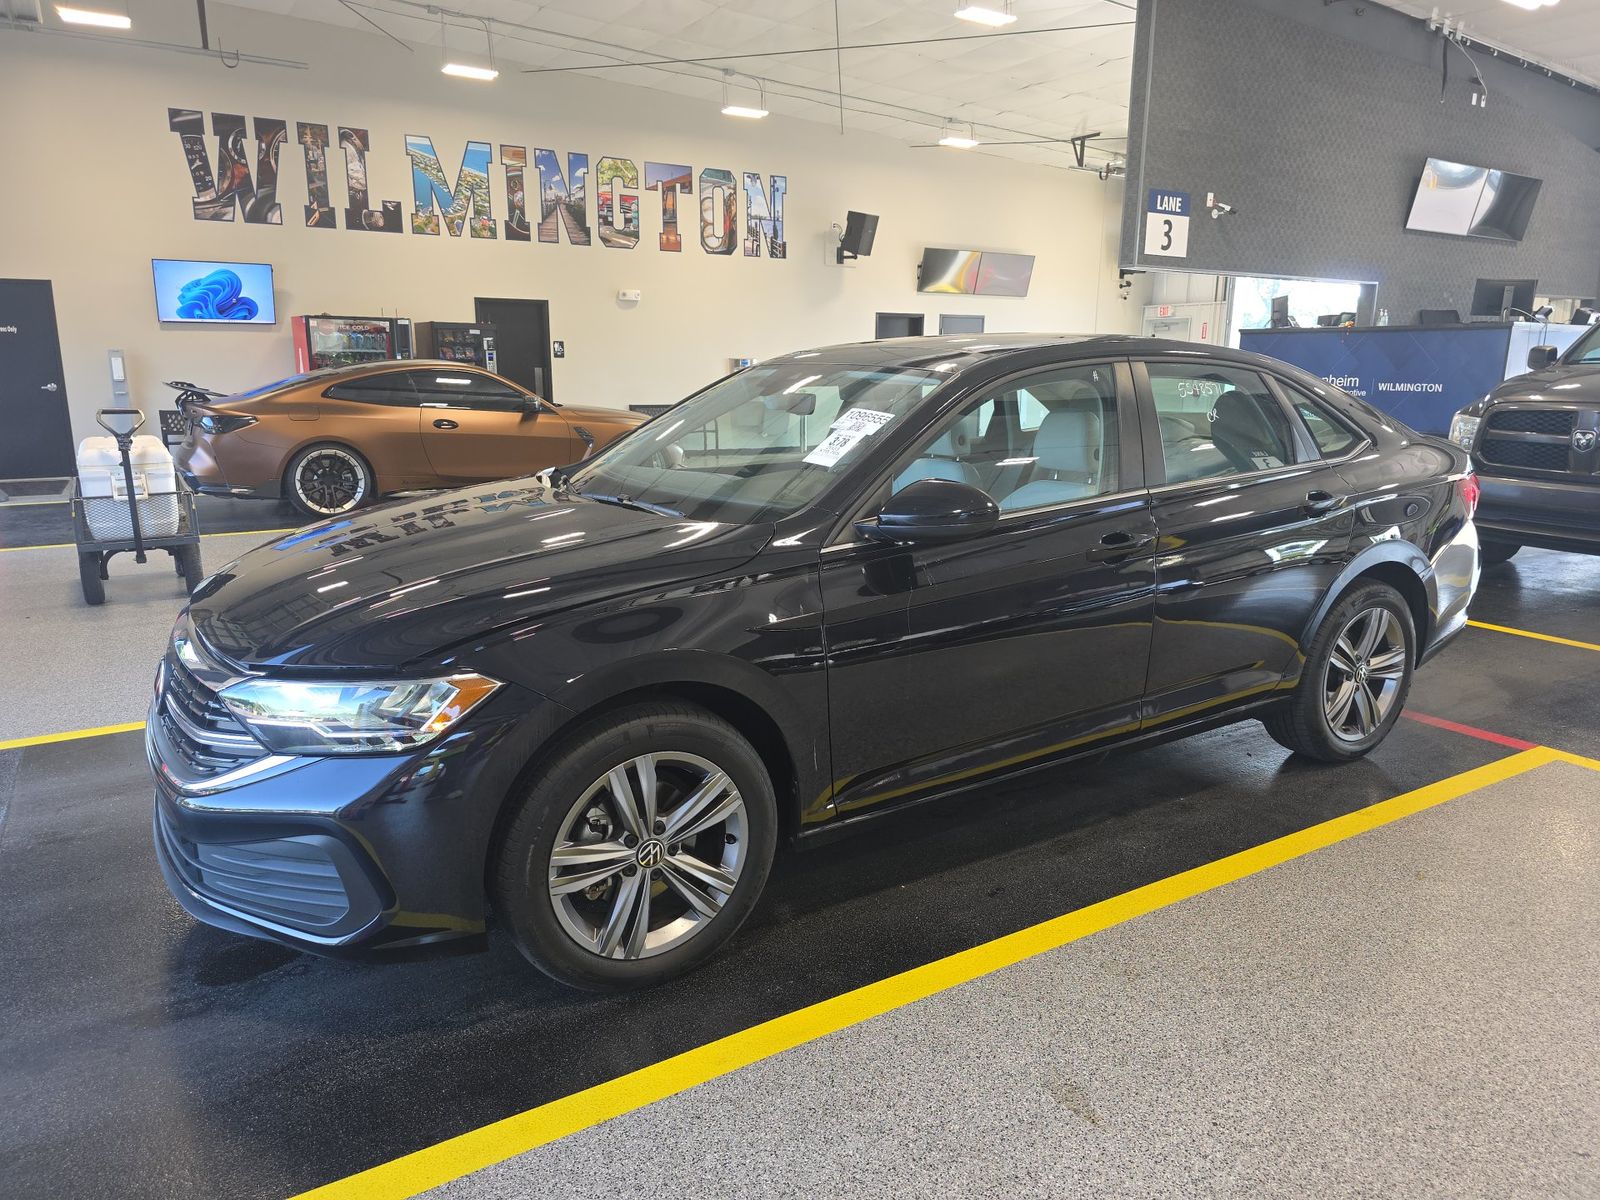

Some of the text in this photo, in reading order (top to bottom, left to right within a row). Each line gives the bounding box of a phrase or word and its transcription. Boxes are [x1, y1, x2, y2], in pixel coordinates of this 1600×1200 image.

[168, 107, 787, 259] WILMINGTON
[1156, 194, 1182, 212] LANE
[1160, 219, 1173, 251] 3
[1378, 382, 1443, 393] WILMINGTON
